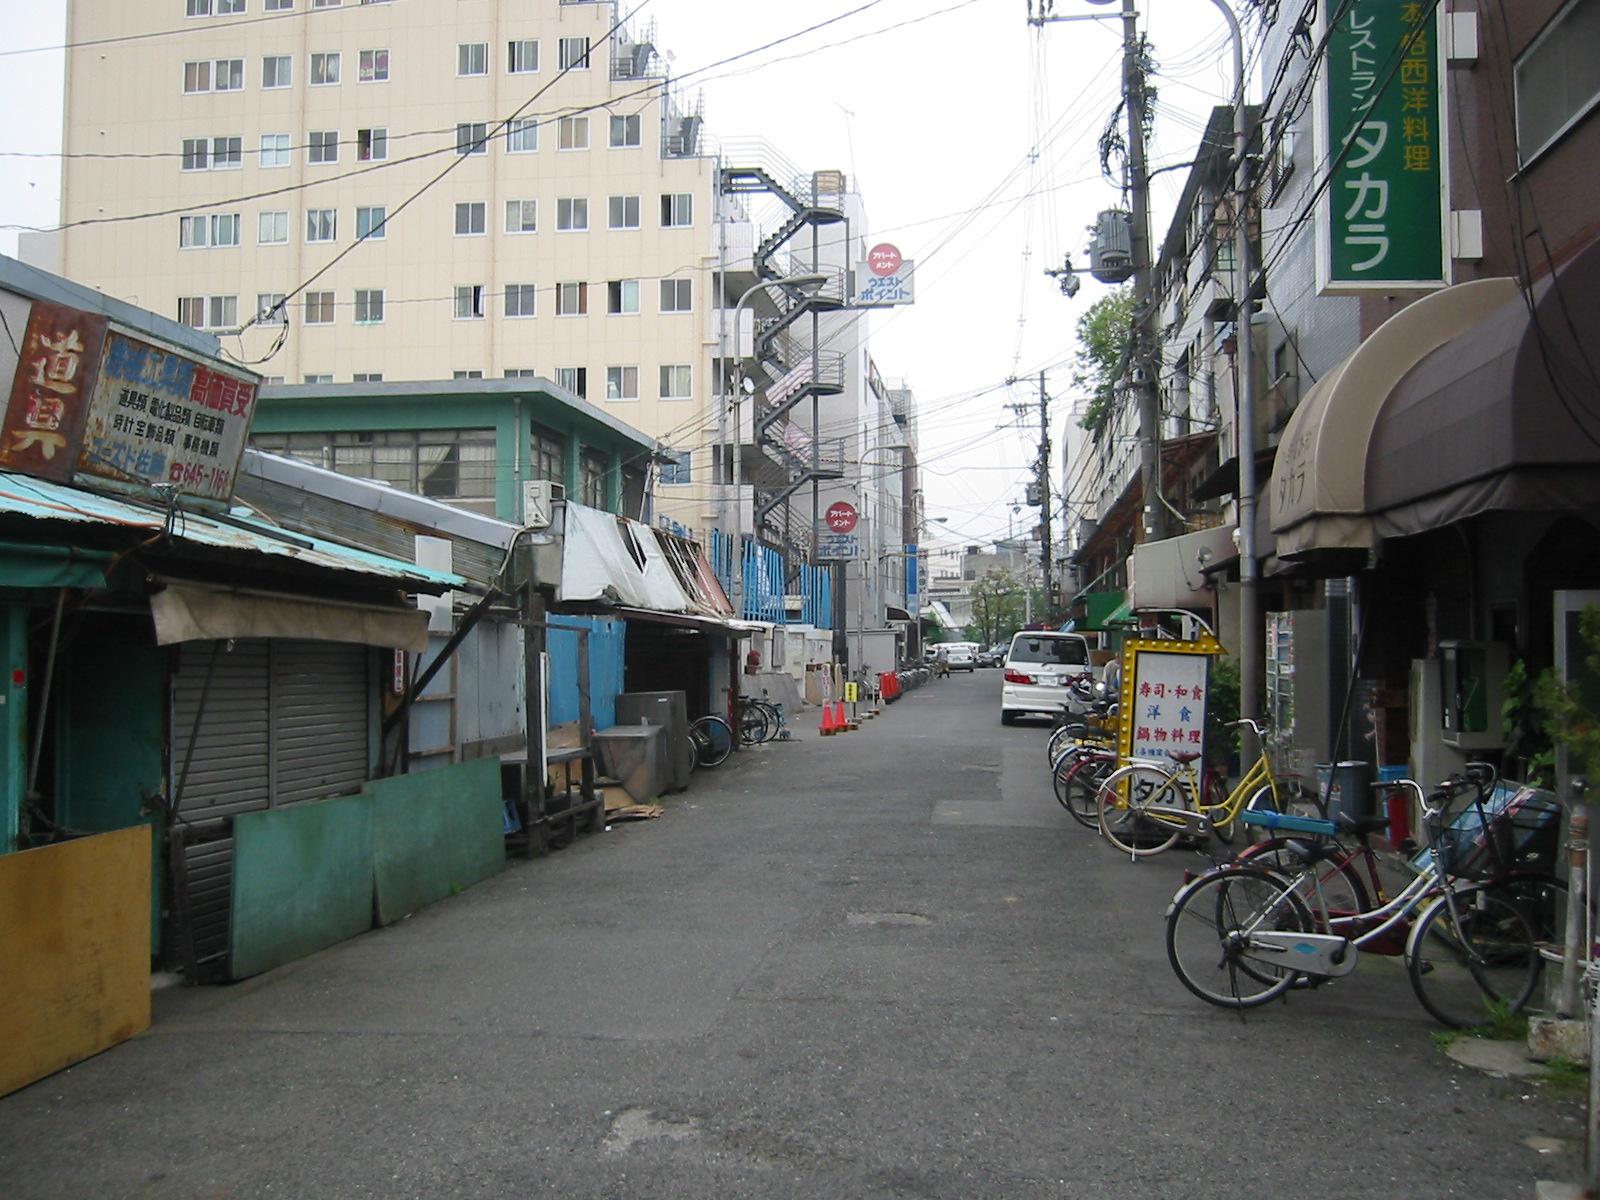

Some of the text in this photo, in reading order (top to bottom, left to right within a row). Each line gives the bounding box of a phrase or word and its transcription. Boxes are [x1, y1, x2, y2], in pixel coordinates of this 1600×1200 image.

[1342, 10, 1389, 271] レストラン タカラ
